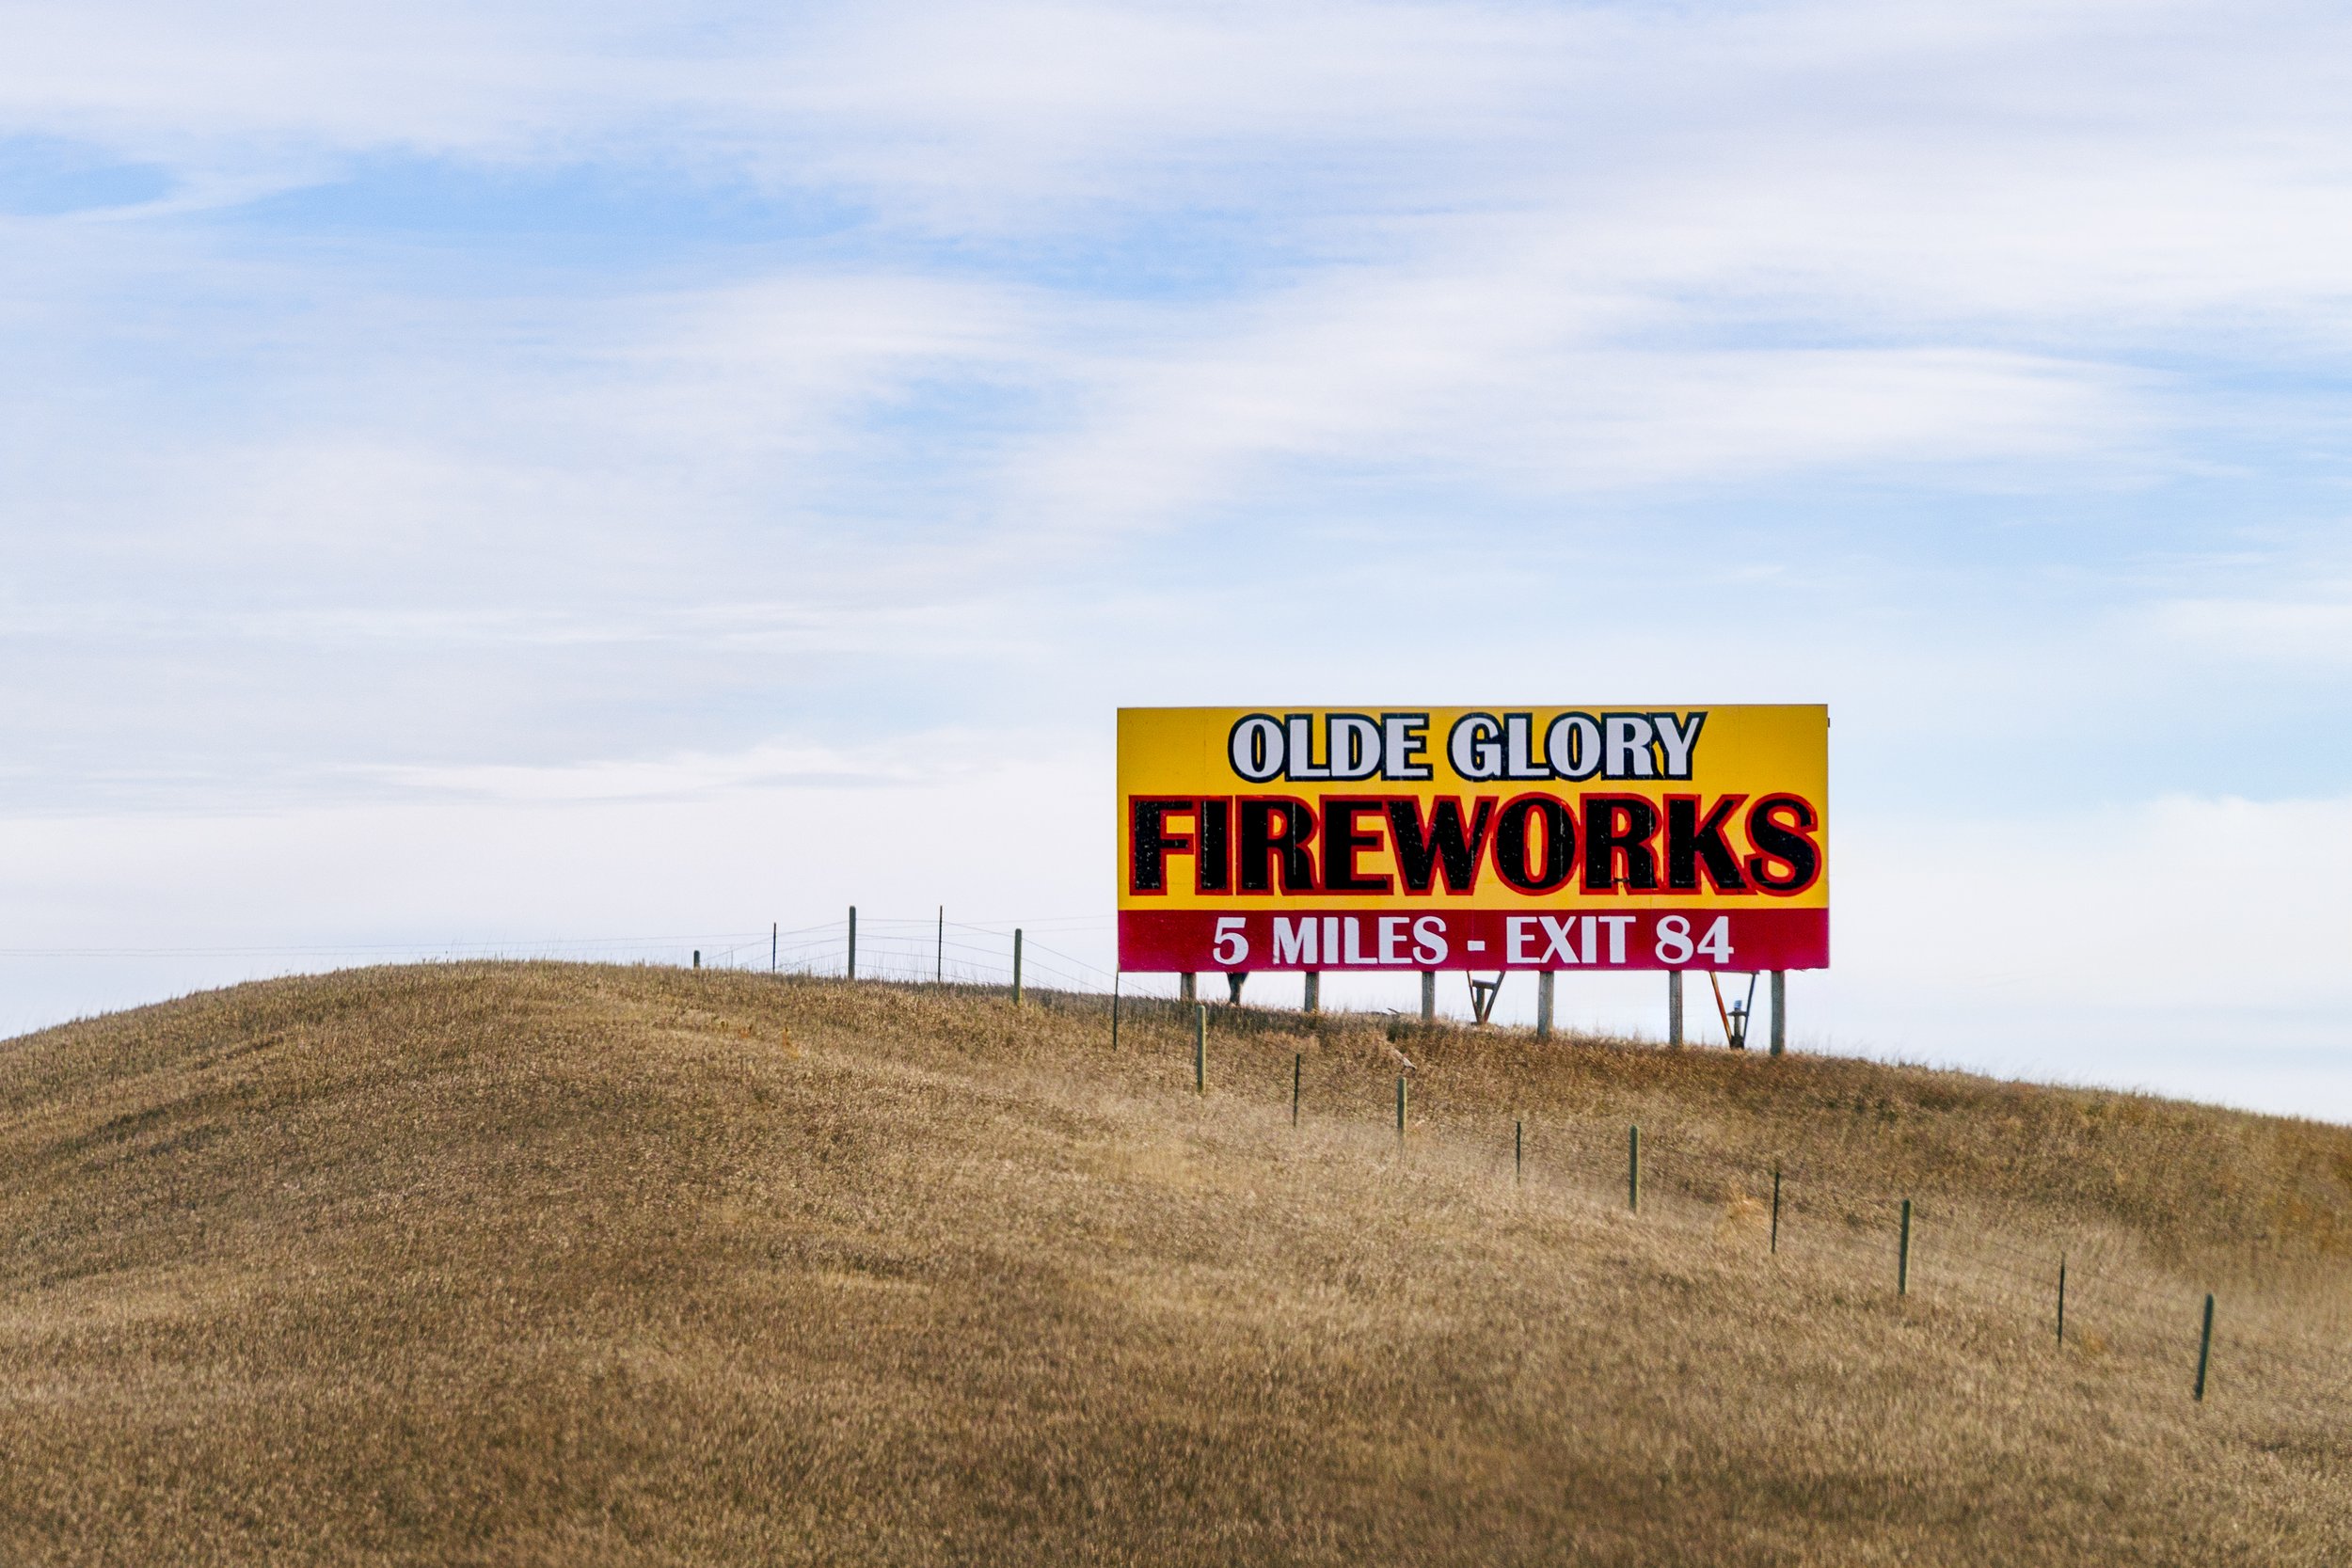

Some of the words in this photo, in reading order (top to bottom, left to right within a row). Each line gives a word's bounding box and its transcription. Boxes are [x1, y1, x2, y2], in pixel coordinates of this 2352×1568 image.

[1228, 712, 1433, 782] OLDE
[1447, 711, 1708, 782] GLORY
[1129, 792, 1821, 896] FIREWORKS
[1213, 916, 1248, 965] 5
[1273, 916, 1449, 965] MILES
[1467, 940, 1485, 951] -
[1506, 916, 1636, 964] EXIT
[1654, 915, 1734, 964] 84
